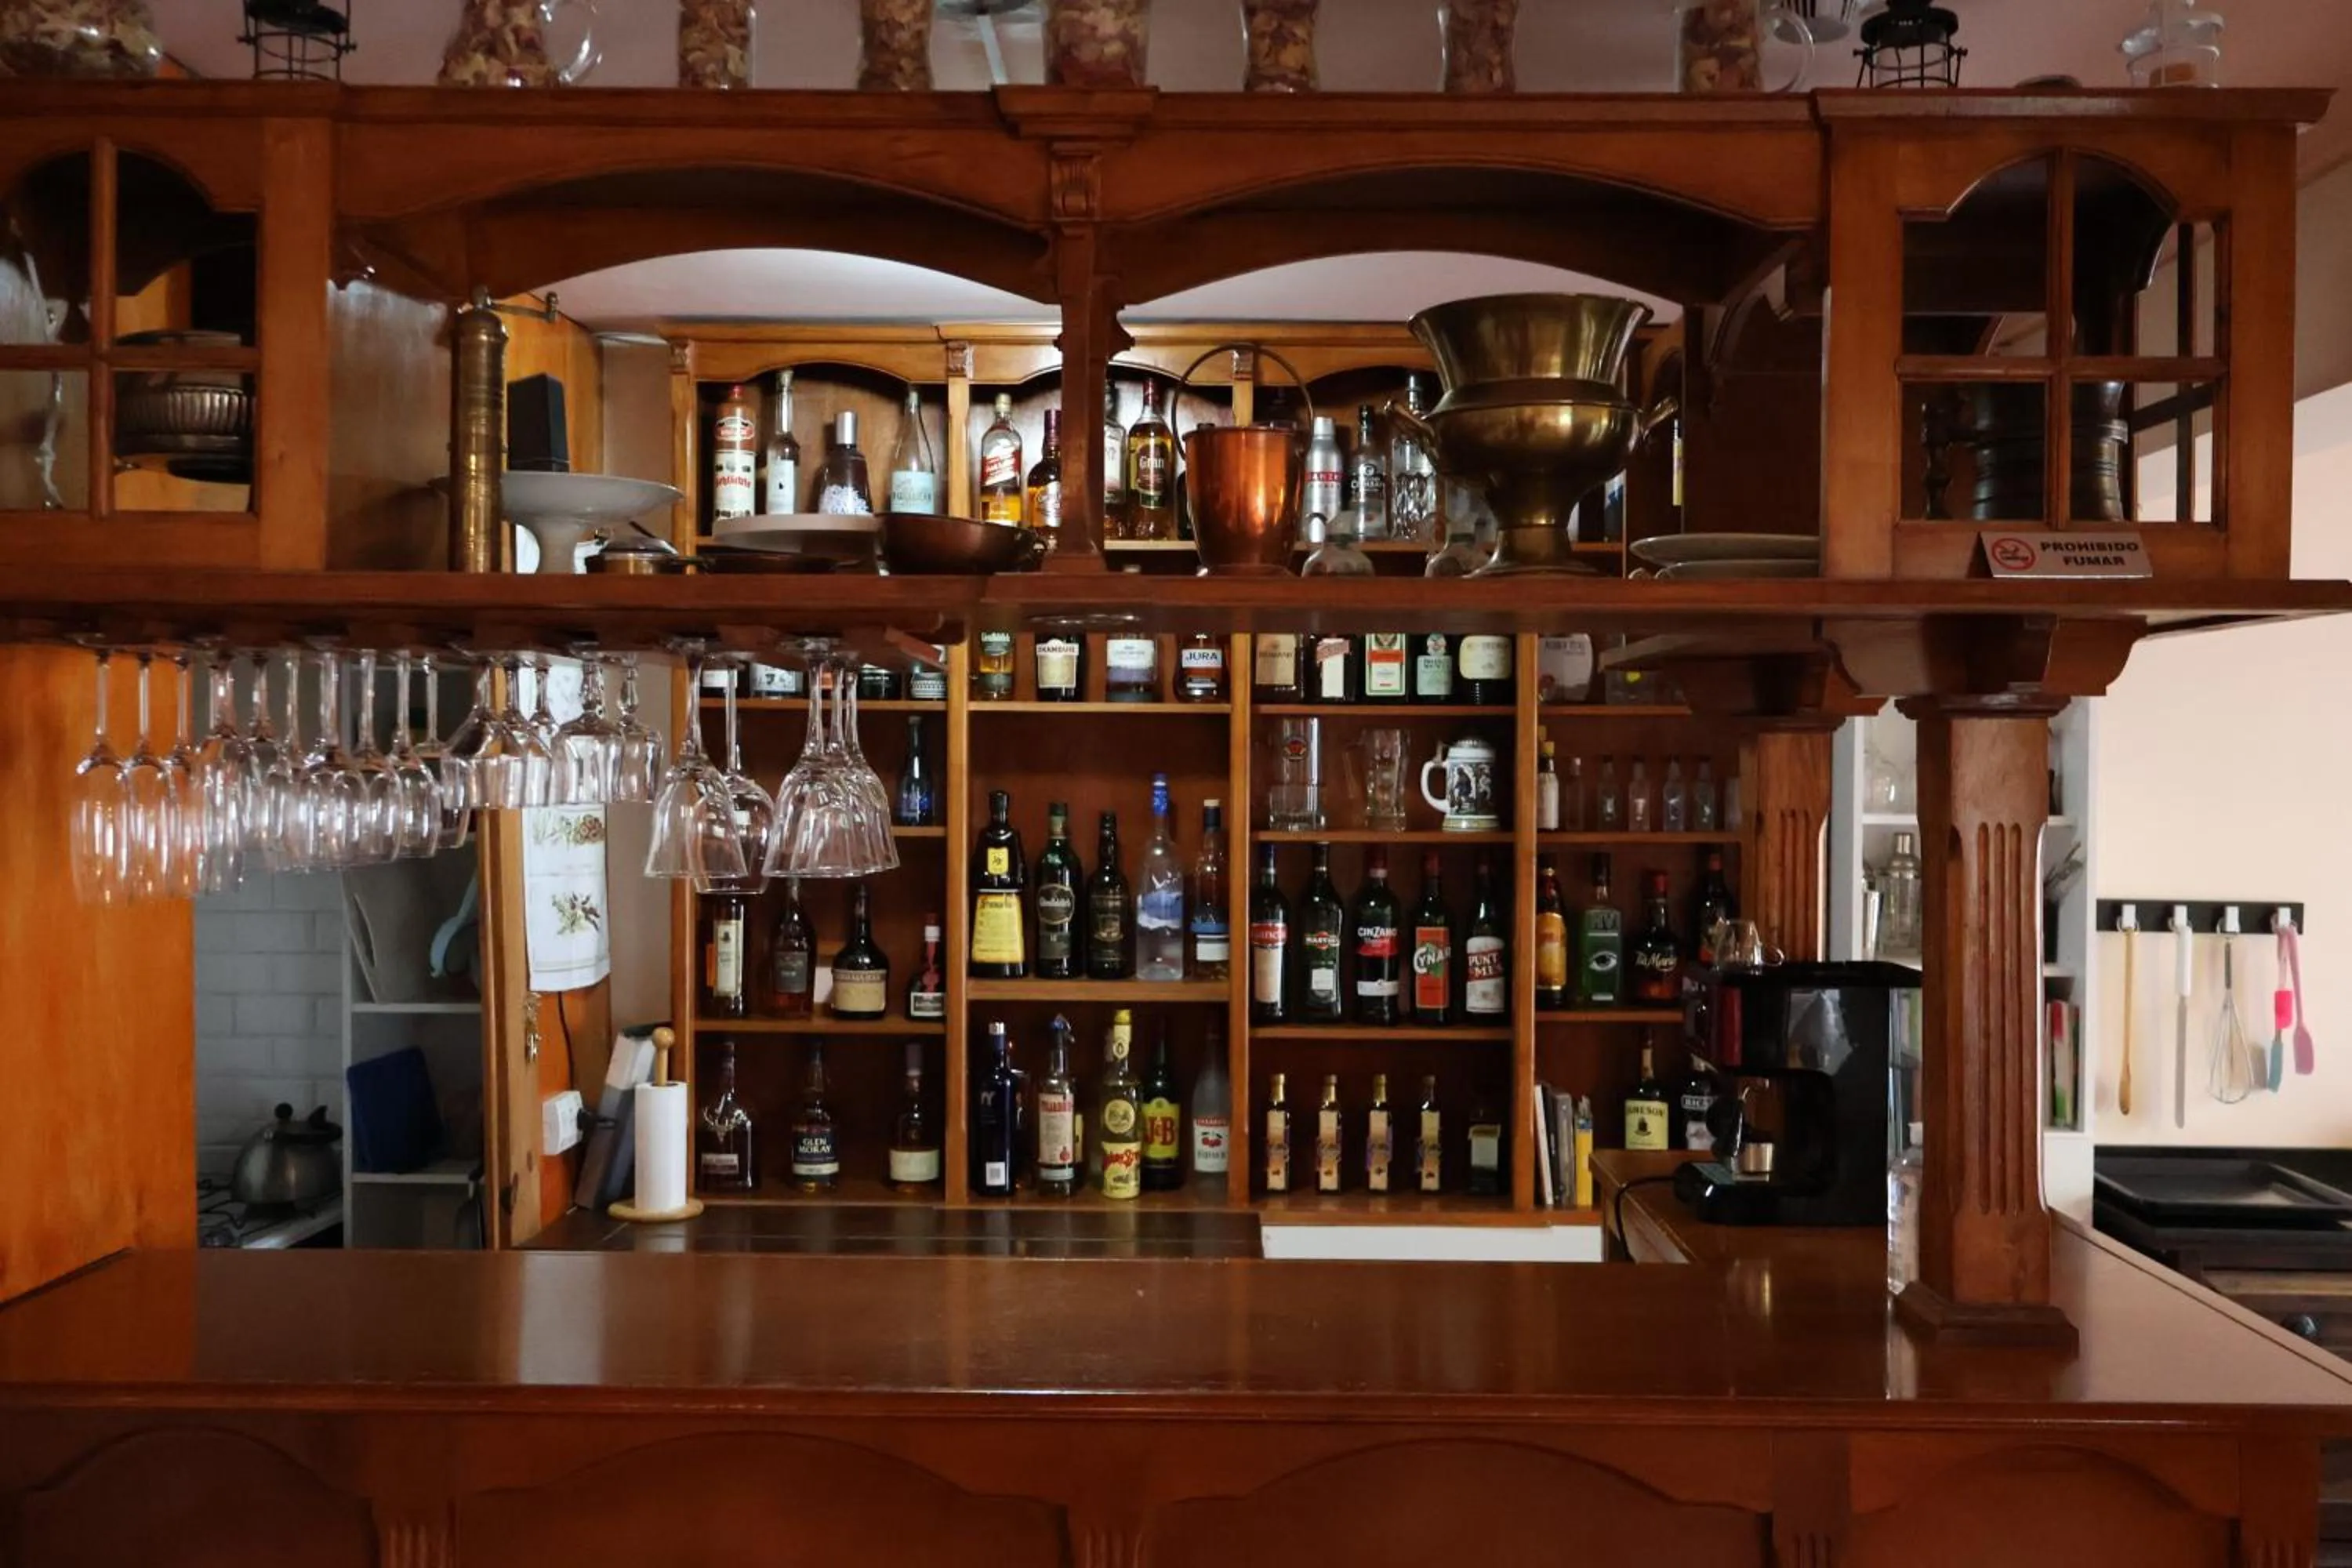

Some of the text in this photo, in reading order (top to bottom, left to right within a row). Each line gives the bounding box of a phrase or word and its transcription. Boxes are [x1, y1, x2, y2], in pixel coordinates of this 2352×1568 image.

[2040, 541, 2140, 552] PROHIBIDO
[2062, 555, 2127, 566] FUMAR
[1187, 652, 1218, 661] JURA
[1357, 927, 1398, 938] CINZANO
[1468, 953, 1498, 967] PUNT
[798, 1145, 831, 1154] MORAY
